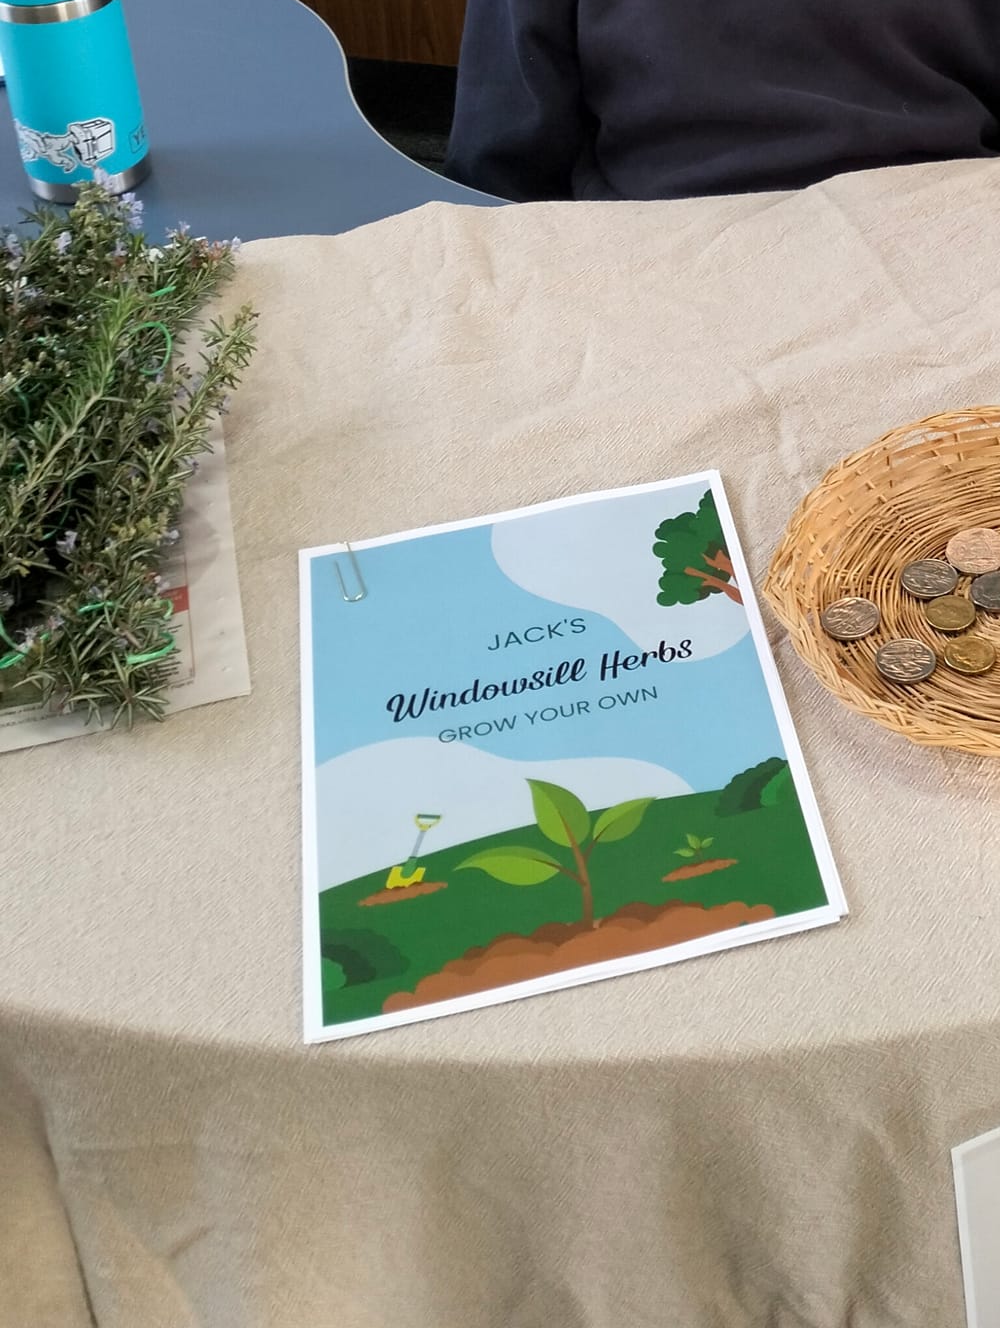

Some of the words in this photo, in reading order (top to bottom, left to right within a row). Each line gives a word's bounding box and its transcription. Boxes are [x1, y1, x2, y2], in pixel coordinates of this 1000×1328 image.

[487, 617, 587, 652] JACK'S
[386, 658, 587, 723] Windowsill
[600, 638, 694, 682] Herbs
[437, 717, 519, 745] GROW
[524, 699, 591, 727] YOUR
[598, 685, 659, 712] OWN
